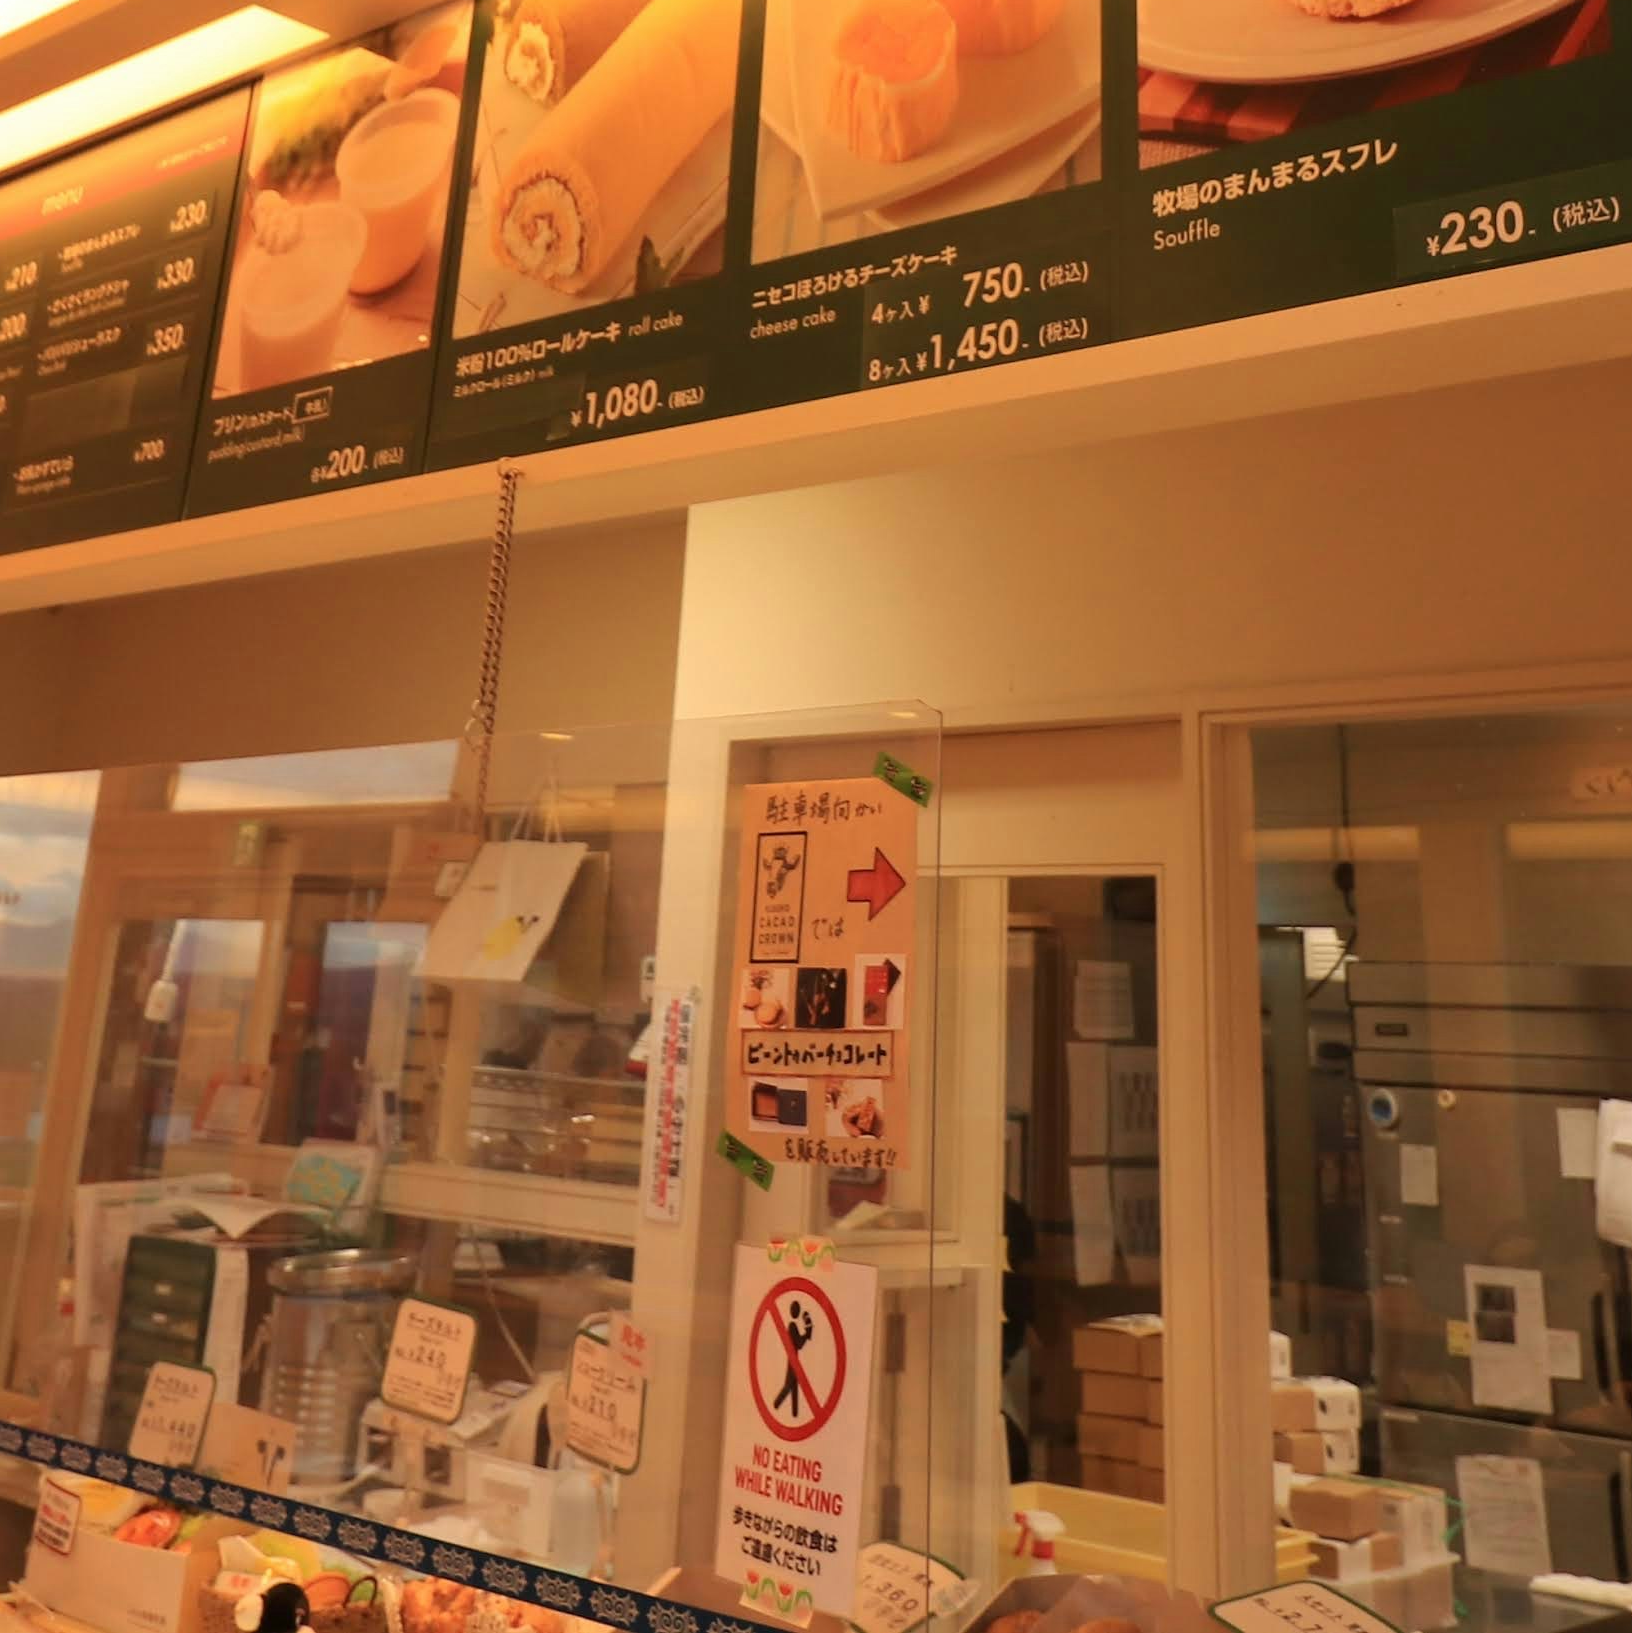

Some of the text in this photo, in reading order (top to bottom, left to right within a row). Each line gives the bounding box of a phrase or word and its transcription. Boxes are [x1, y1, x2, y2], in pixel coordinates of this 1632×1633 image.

[1152, 139, 1397, 216] 牧場のまんまるスフレ
[1553, 196, 1620, 231] (税込)
[1153, 219, 1221, 250] Souffle
[752, 245, 957, 309] ニセコほろけるチーズケーキ
[1040, 261, 1089, 291] (税込)
[628, 316, 650, 337] roll
[652, 311, 683, 331] cake
[749, 306, 836, 340] cheese cake
[1039, 317, 1088, 347] (税込)
[766, 789, 882, 825] 駐車場向かい
[758, 932, 795, 945] CROWN
[759, 915, 795, 928] CACAO
[812, 917, 846, 941] では
[753, 1444, 822, 1482] NO EATING
[735, 1465, 843, 1516] WHILE WALKING
[732, 1505, 838, 1553] 歩きながらの飲食は
[742, 1537, 821, 1576] ご遠慮ください
